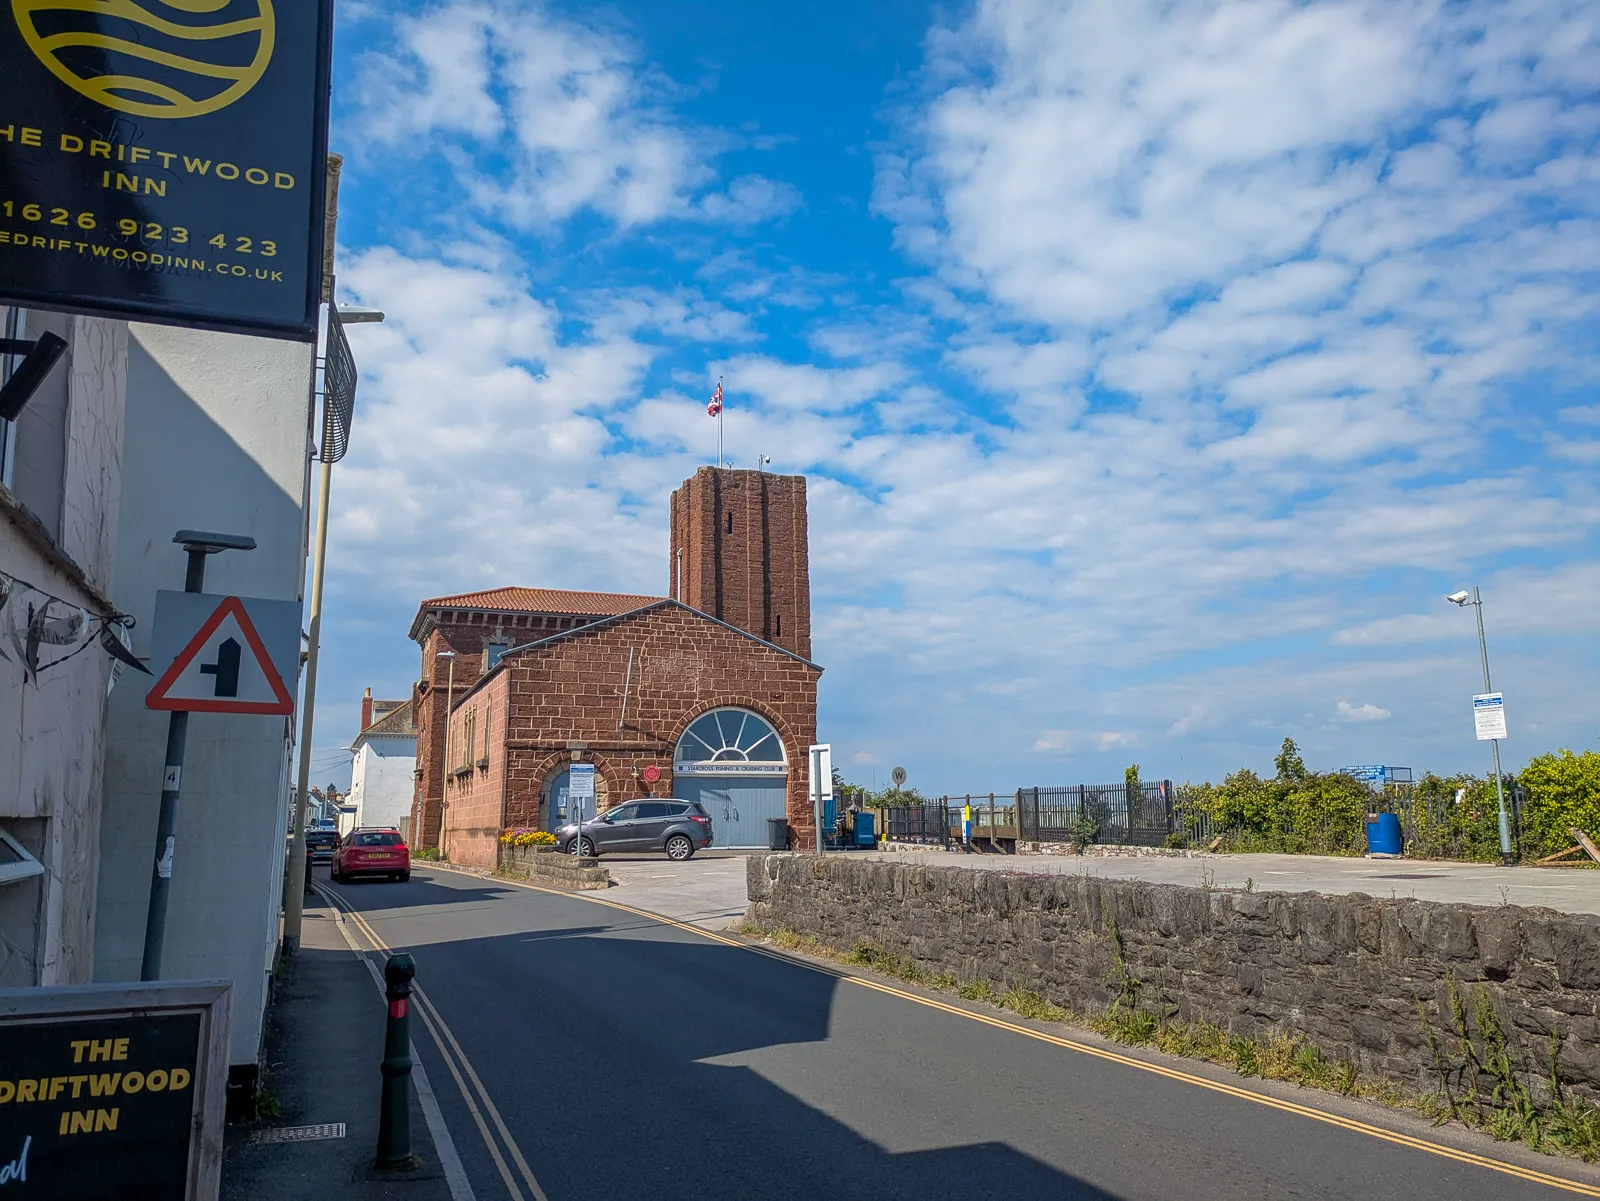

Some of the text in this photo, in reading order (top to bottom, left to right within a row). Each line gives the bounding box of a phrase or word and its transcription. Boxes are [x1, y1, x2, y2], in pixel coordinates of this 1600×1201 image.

[0, 124, 296, 190] HE DRIFTWOOD
[102, 170, 167, 197] INN
[3, 200, 278, 257] 1626 923 423
[0, 231, 283, 282] EDRIFTWOODINN.CO.UK
[167, 771, 176, 783] 4
[894, 770, 904, 780] W
[70, 1037, 130, 1063] THE
[0, 1068, 191, 1103] DRIFTWOOD
[59, 1108, 120, 1135] INN
